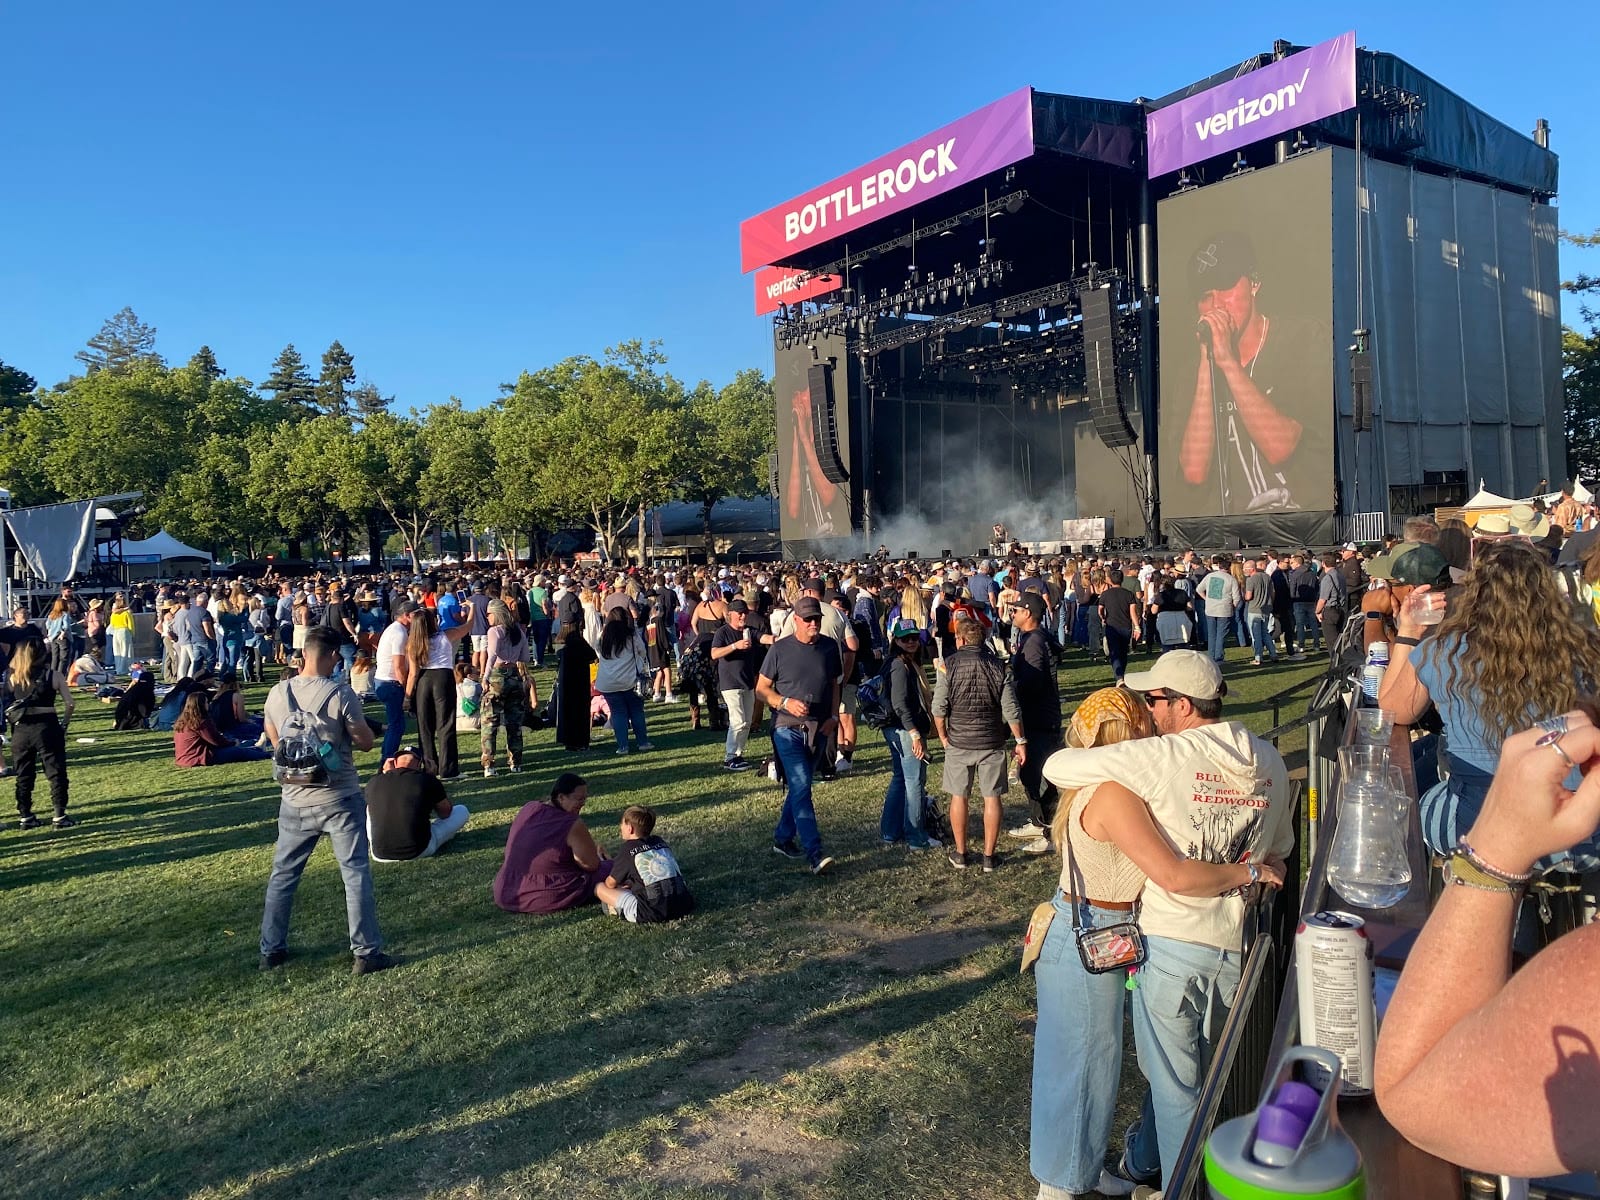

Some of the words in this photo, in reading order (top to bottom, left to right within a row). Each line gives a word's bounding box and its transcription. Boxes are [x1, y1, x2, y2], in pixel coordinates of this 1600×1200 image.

[1195, 84, 1296, 141] verizon
[785, 137, 958, 242] BOTTLEROCK
[766, 274, 809, 299] veriz
[1192, 793, 1271, 809] REDWOODS
